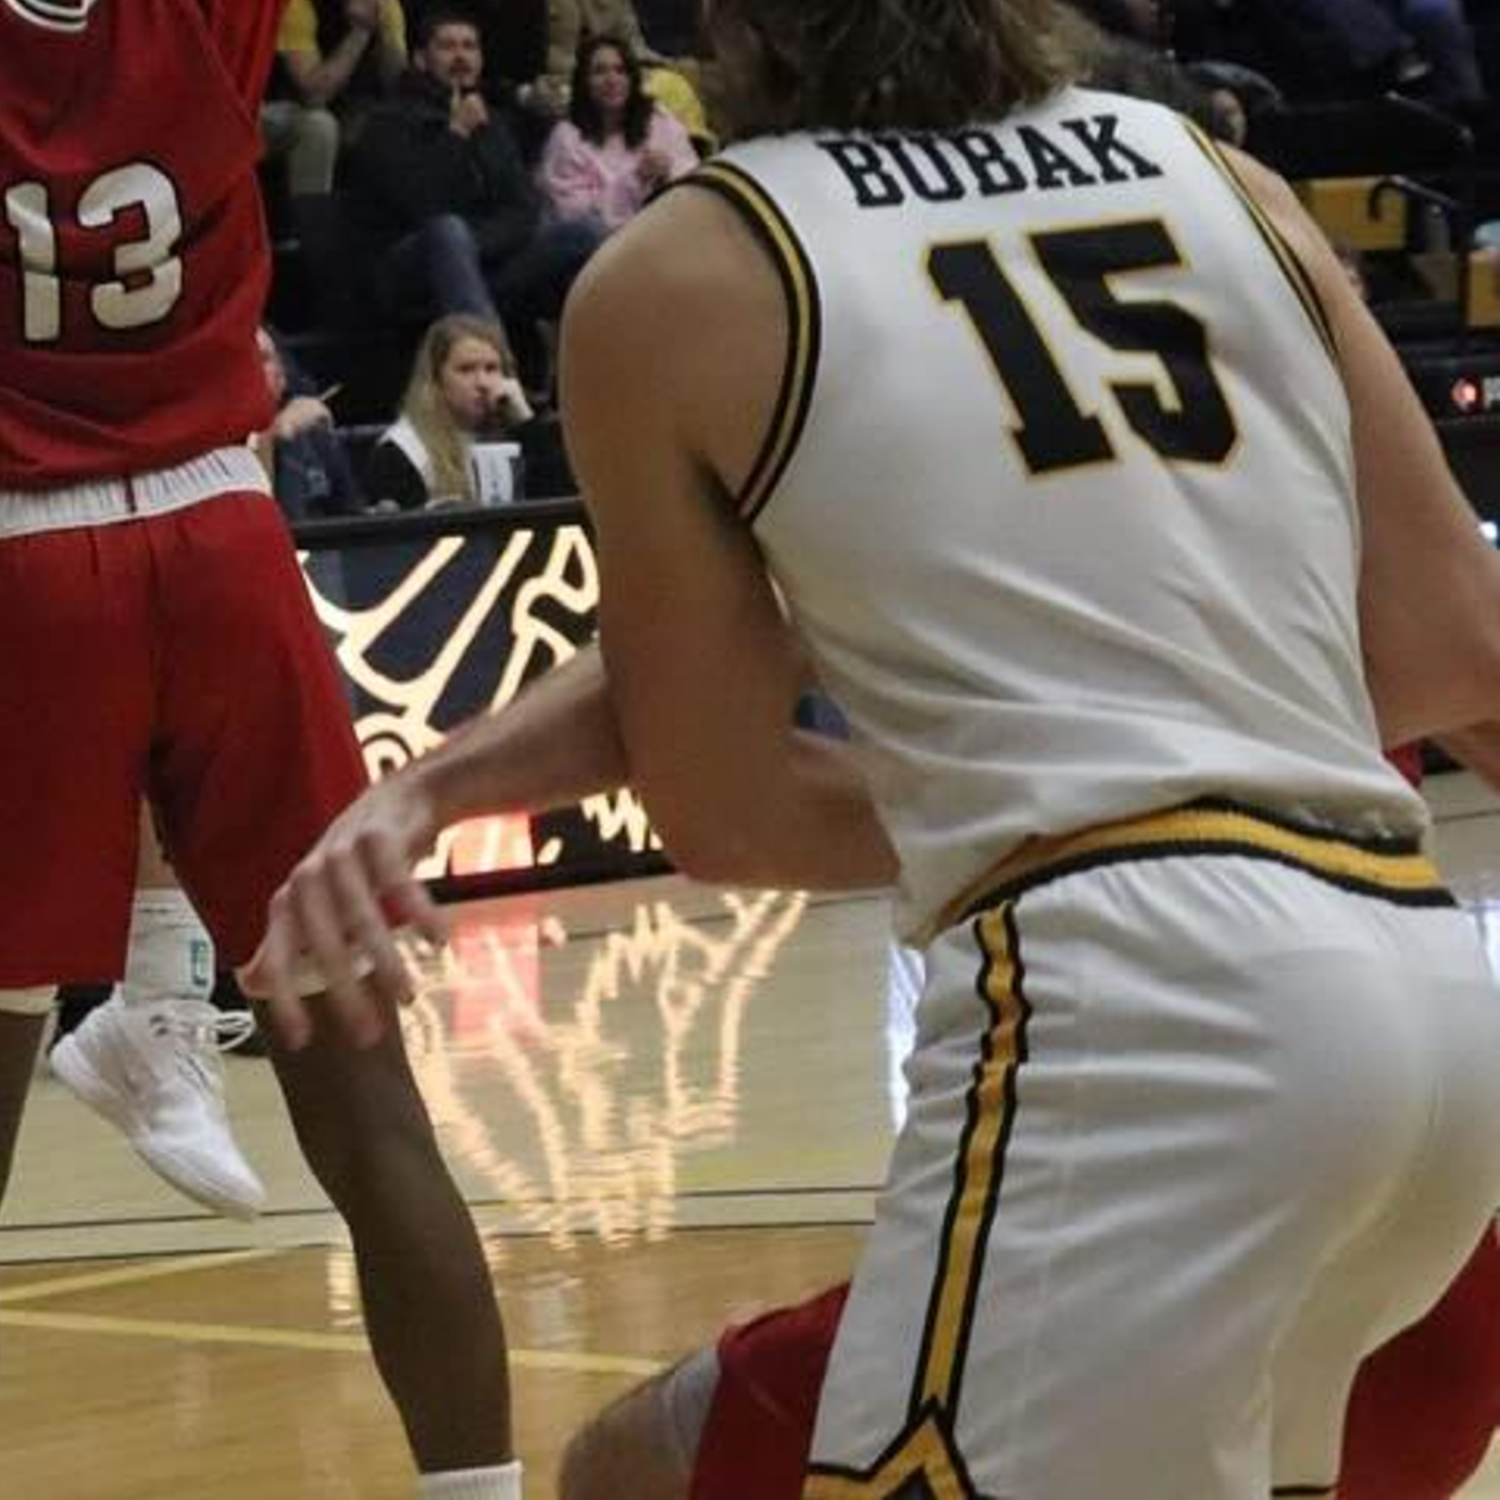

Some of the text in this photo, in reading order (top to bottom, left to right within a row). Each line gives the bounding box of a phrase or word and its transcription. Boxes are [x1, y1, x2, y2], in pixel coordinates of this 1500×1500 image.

[4, 161, 184, 342] 13
[815, 114, 1164, 208] BUBAK
[922, 214, 1242, 477] 15
